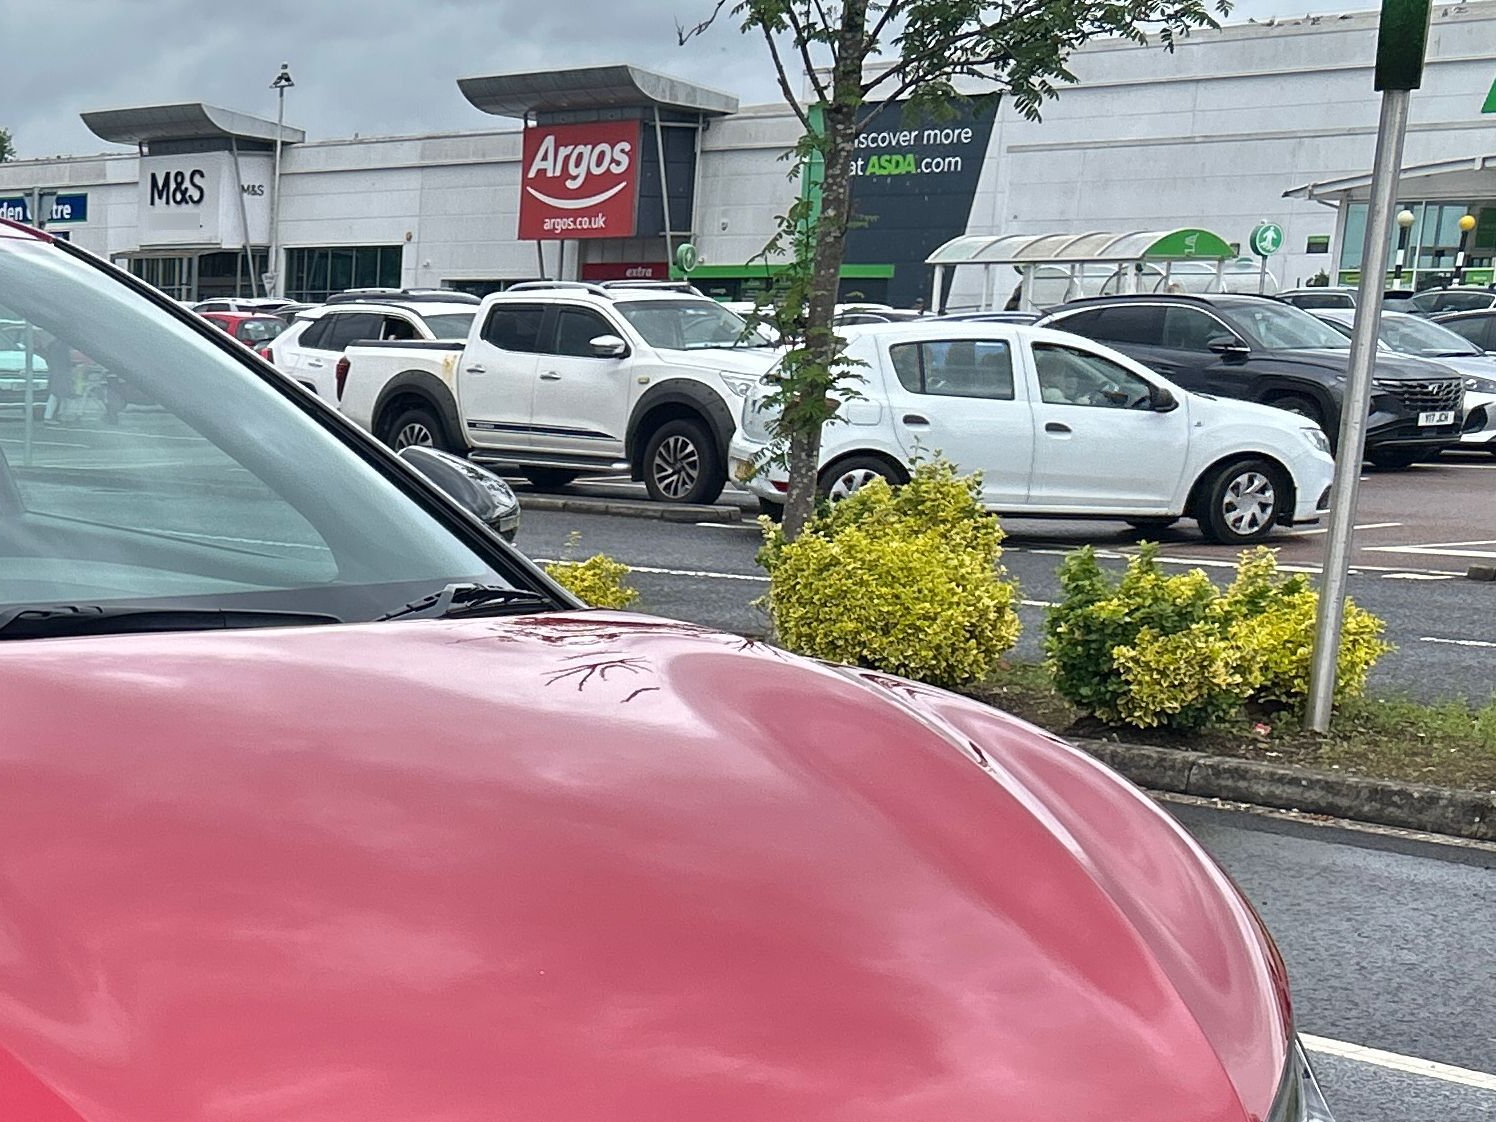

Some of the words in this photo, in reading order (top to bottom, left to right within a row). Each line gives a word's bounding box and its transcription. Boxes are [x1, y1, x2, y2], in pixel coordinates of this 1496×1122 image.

[854, 130, 919, 148] scover
[923, 127, 973, 145] more
[527, 135, 632, 190] Argos
[849, 156, 864, 176] at
[865, 154, 962, 175] ASDA.com
[150, 169, 205, 206] M&S
[241, 184, 264, 196] M&S
[26, 203, 71, 219] tre
[543, 213, 606, 233] argos.co.uk
[625, 266, 653, 278] extra
